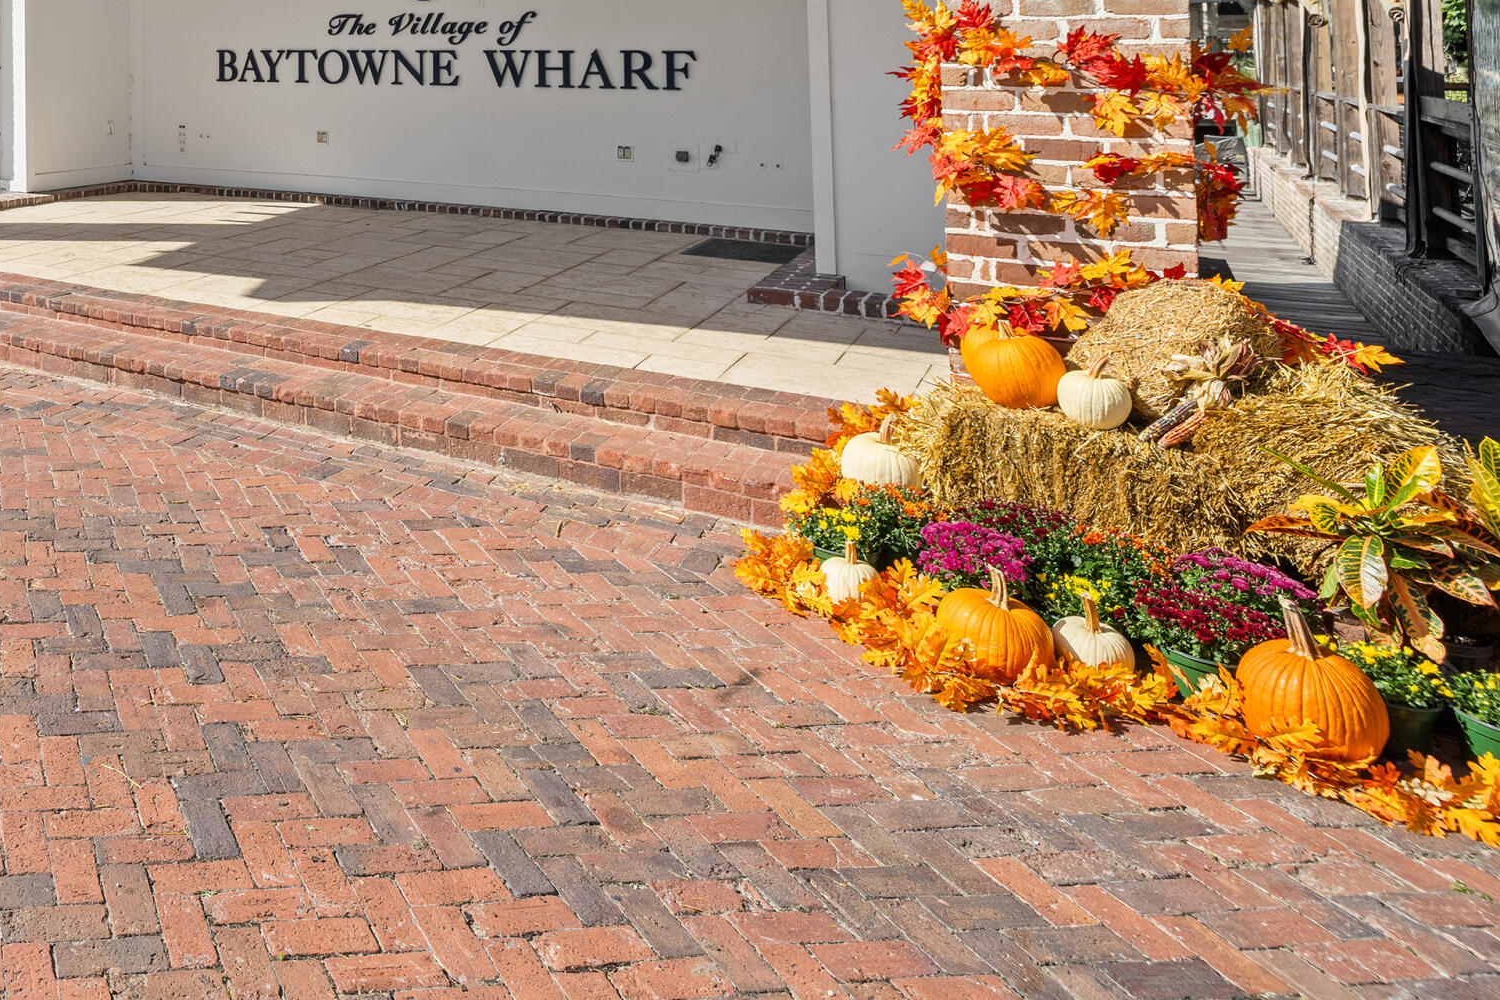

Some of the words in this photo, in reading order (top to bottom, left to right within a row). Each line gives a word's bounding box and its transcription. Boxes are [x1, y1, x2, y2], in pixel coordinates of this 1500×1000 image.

[327, 13, 376, 36] The
[388, 12, 488, 46] Village
[496, 10, 538, 46] of
[216, 48, 460, 87] BAYTOWNE
[483, 48, 697, 91] WHARF
